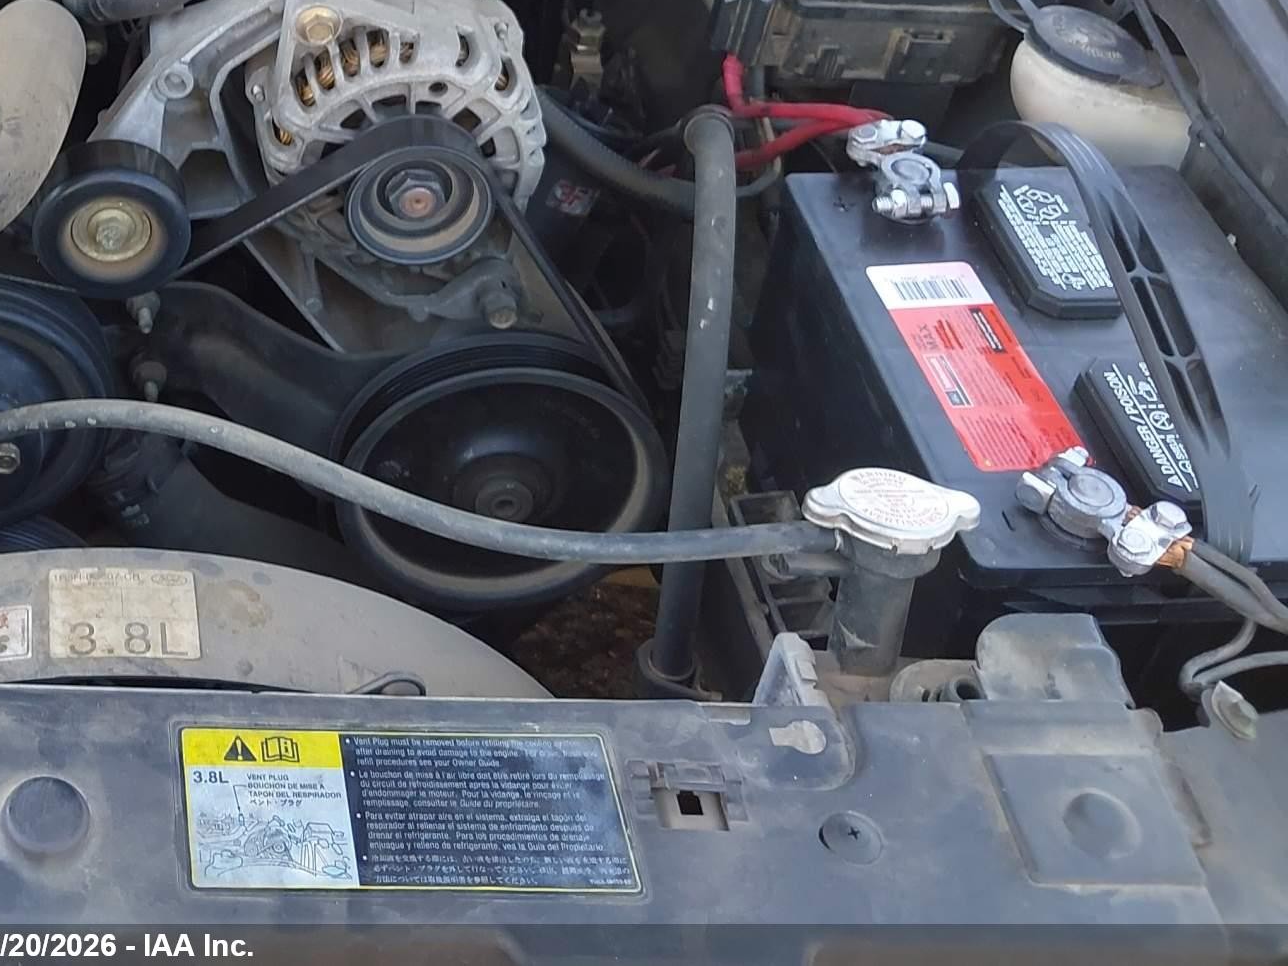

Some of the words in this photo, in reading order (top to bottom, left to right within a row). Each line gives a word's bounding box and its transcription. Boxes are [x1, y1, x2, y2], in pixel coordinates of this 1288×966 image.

[1103, 371, 1139, 415] POISON
[1137, 425, 1176, 475] DANGER
[69, 621, 189, 656] 3.8L
[193, 770, 229, 784] 3.8L
[247, 773, 266, 781] VENT
[268, 774, 289, 782] PLUG
[365, 812, 383, 821] Para
